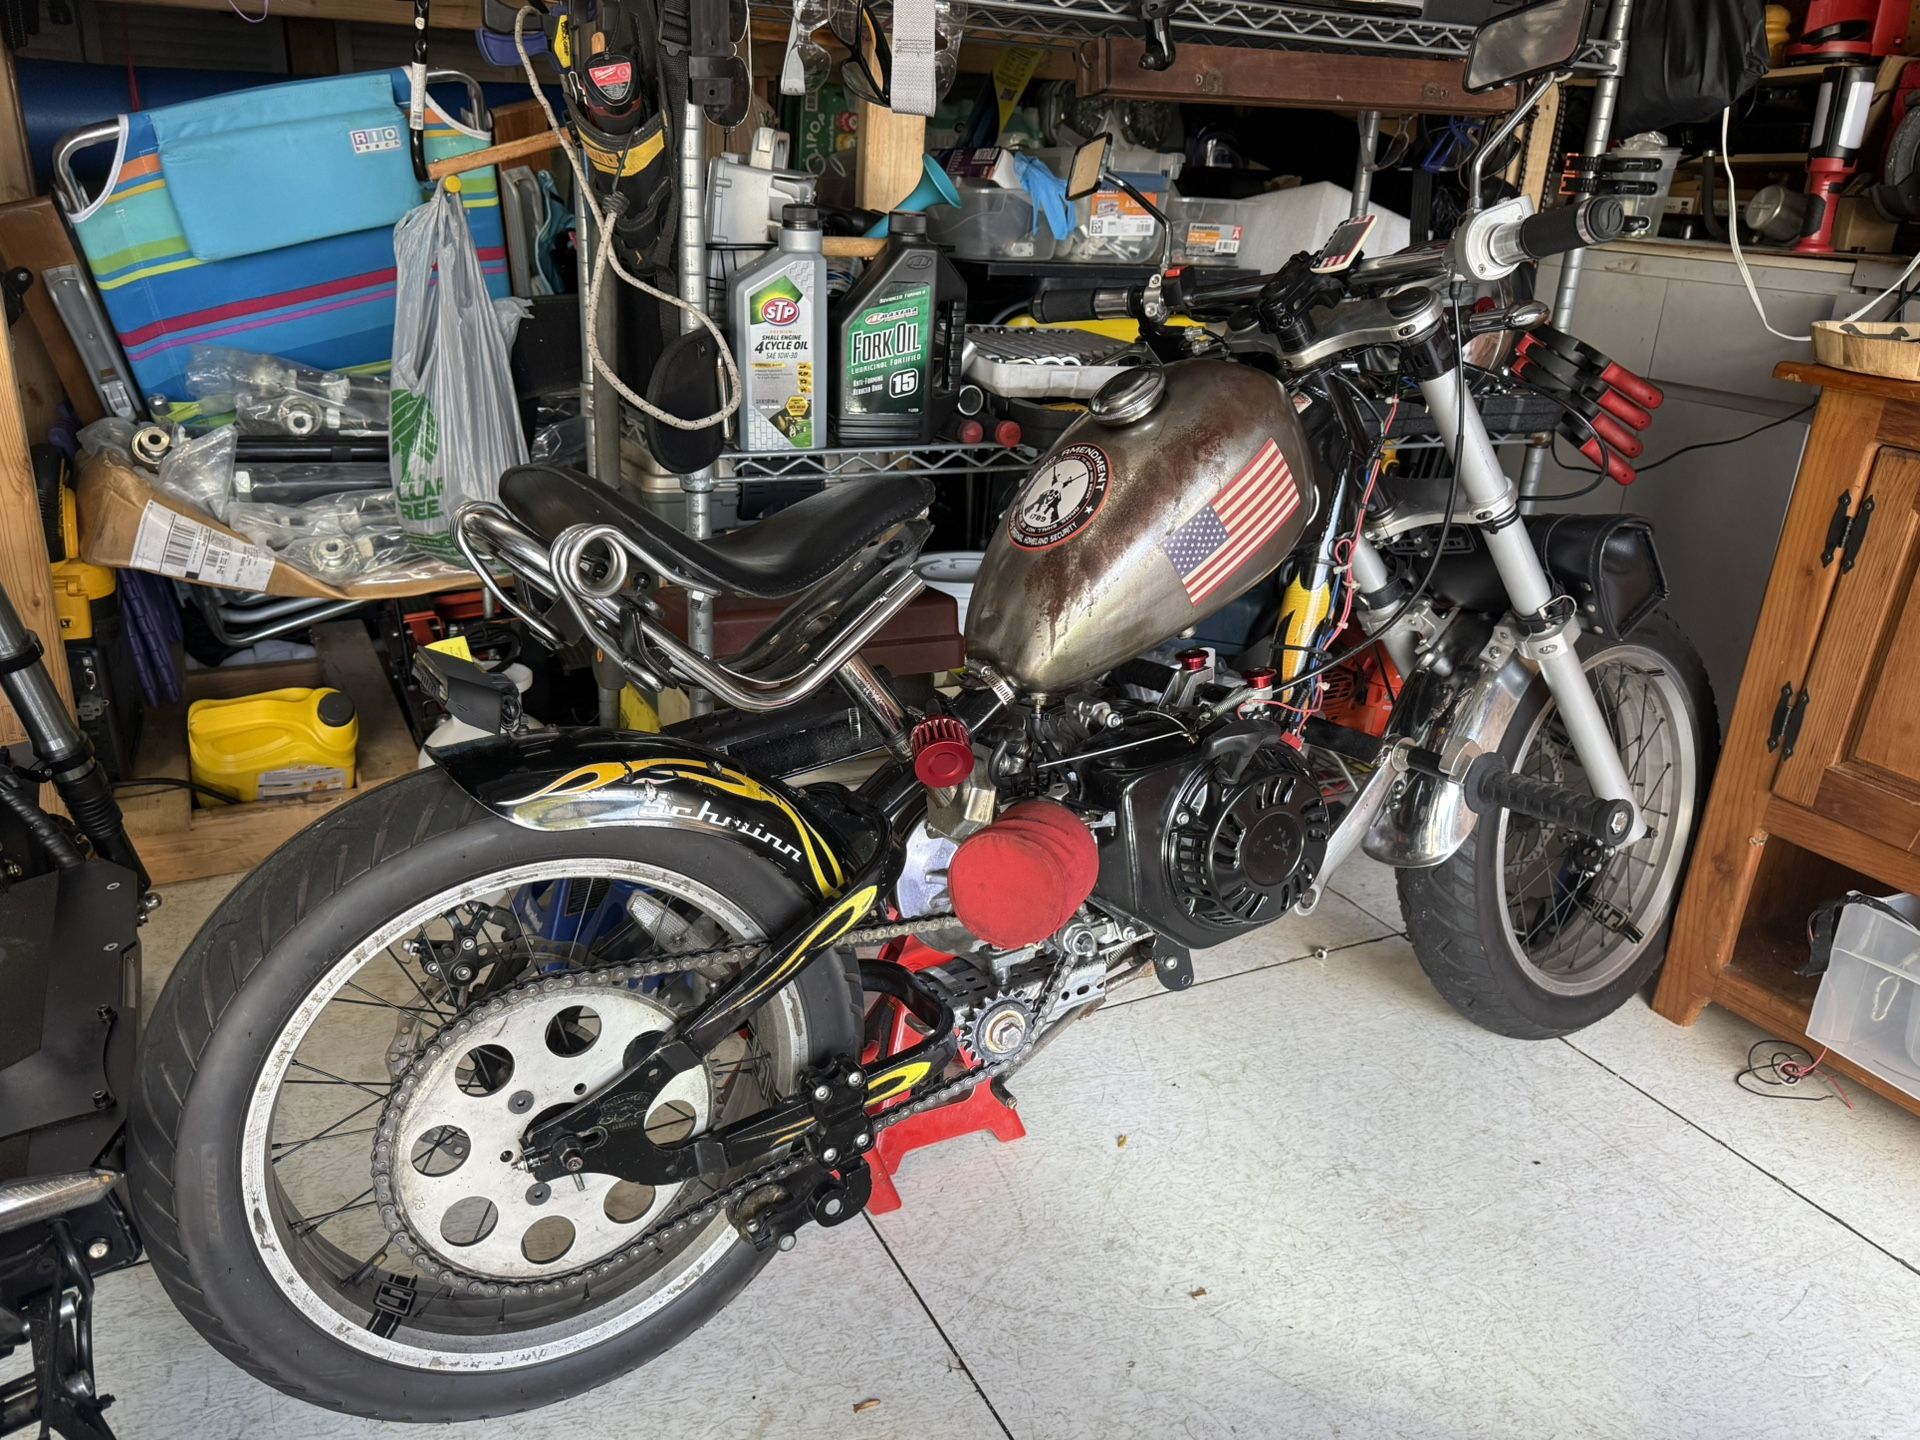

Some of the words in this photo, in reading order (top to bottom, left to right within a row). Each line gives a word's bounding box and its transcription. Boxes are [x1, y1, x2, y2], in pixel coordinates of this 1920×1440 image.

[354, 129, 396, 144] RIO
[766, 301, 795, 321] STP
[754, 341, 764, 354] 4
[764, 341, 792, 351] CYCLE
[793, 341, 809, 350] OIL
[851, 328, 895, 366] FORK
[895, 321, 922, 355] OIL
[766, 351, 777, 360] SAE
[889, 354, 921, 366] FORTIFIED
[892, 371, 916, 394] 15
[1061, 445, 1107, 492] AMENDMENT
[400, 499, 444, 521] REE
[1029, 513, 1047, 523] 1789
[1049, 521, 1078, 543] SECURITY
